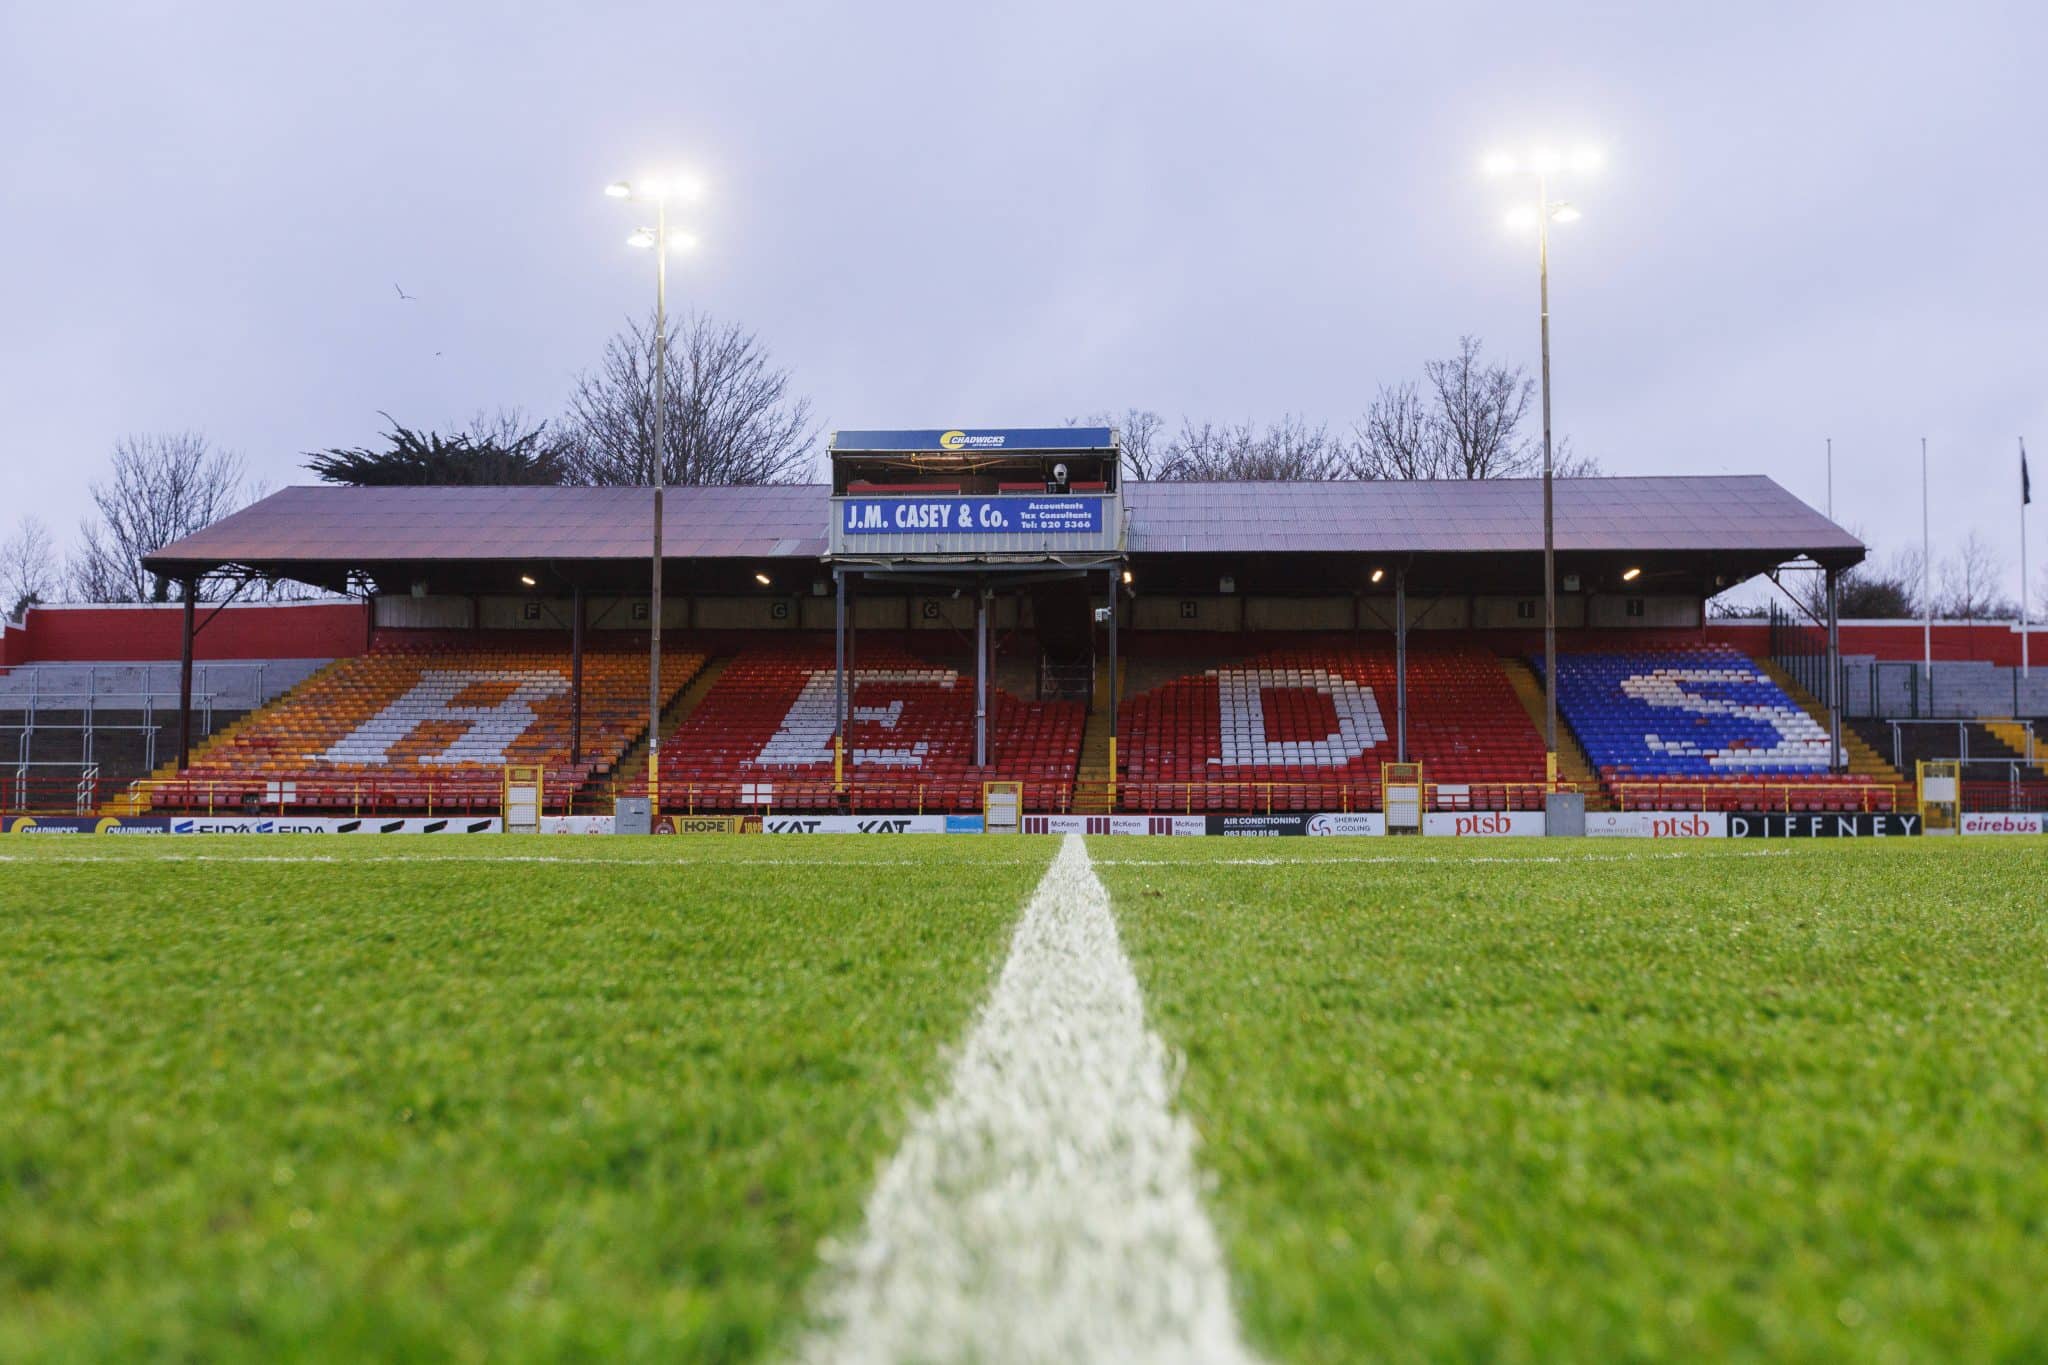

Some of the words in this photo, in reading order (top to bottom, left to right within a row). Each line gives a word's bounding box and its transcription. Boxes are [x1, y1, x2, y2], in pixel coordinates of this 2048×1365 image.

[951, 435, 1005, 445] CHADWICKS
[1028, 502, 1084, 510] Accountants
[848, 505, 888, 528] J.M.
[895, 504, 951, 528] CASEY
[958, 503, 973, 527] &
[979, 503, 1009, 528] Co.
[1020, 511, 1037, 519] Tax
[1039, 511, 1092, 519] Consultants
[527, 603, 538, 618] F
[773, 603, 786, 617] G
[925, 603, 938, 617] G
[1182, 603, 1195, 617] H
[684, 821, 726, 832] HOPE
[1239, 816, 1301, 825] CONDITIONING
[1456, 811, 1511, 836] ptsb
[1653, 814, 1709, 838] ptsb
[1732, 816, 1916, 838] DIFFNEY
[1966, 816, 2037, 832] eirebus
